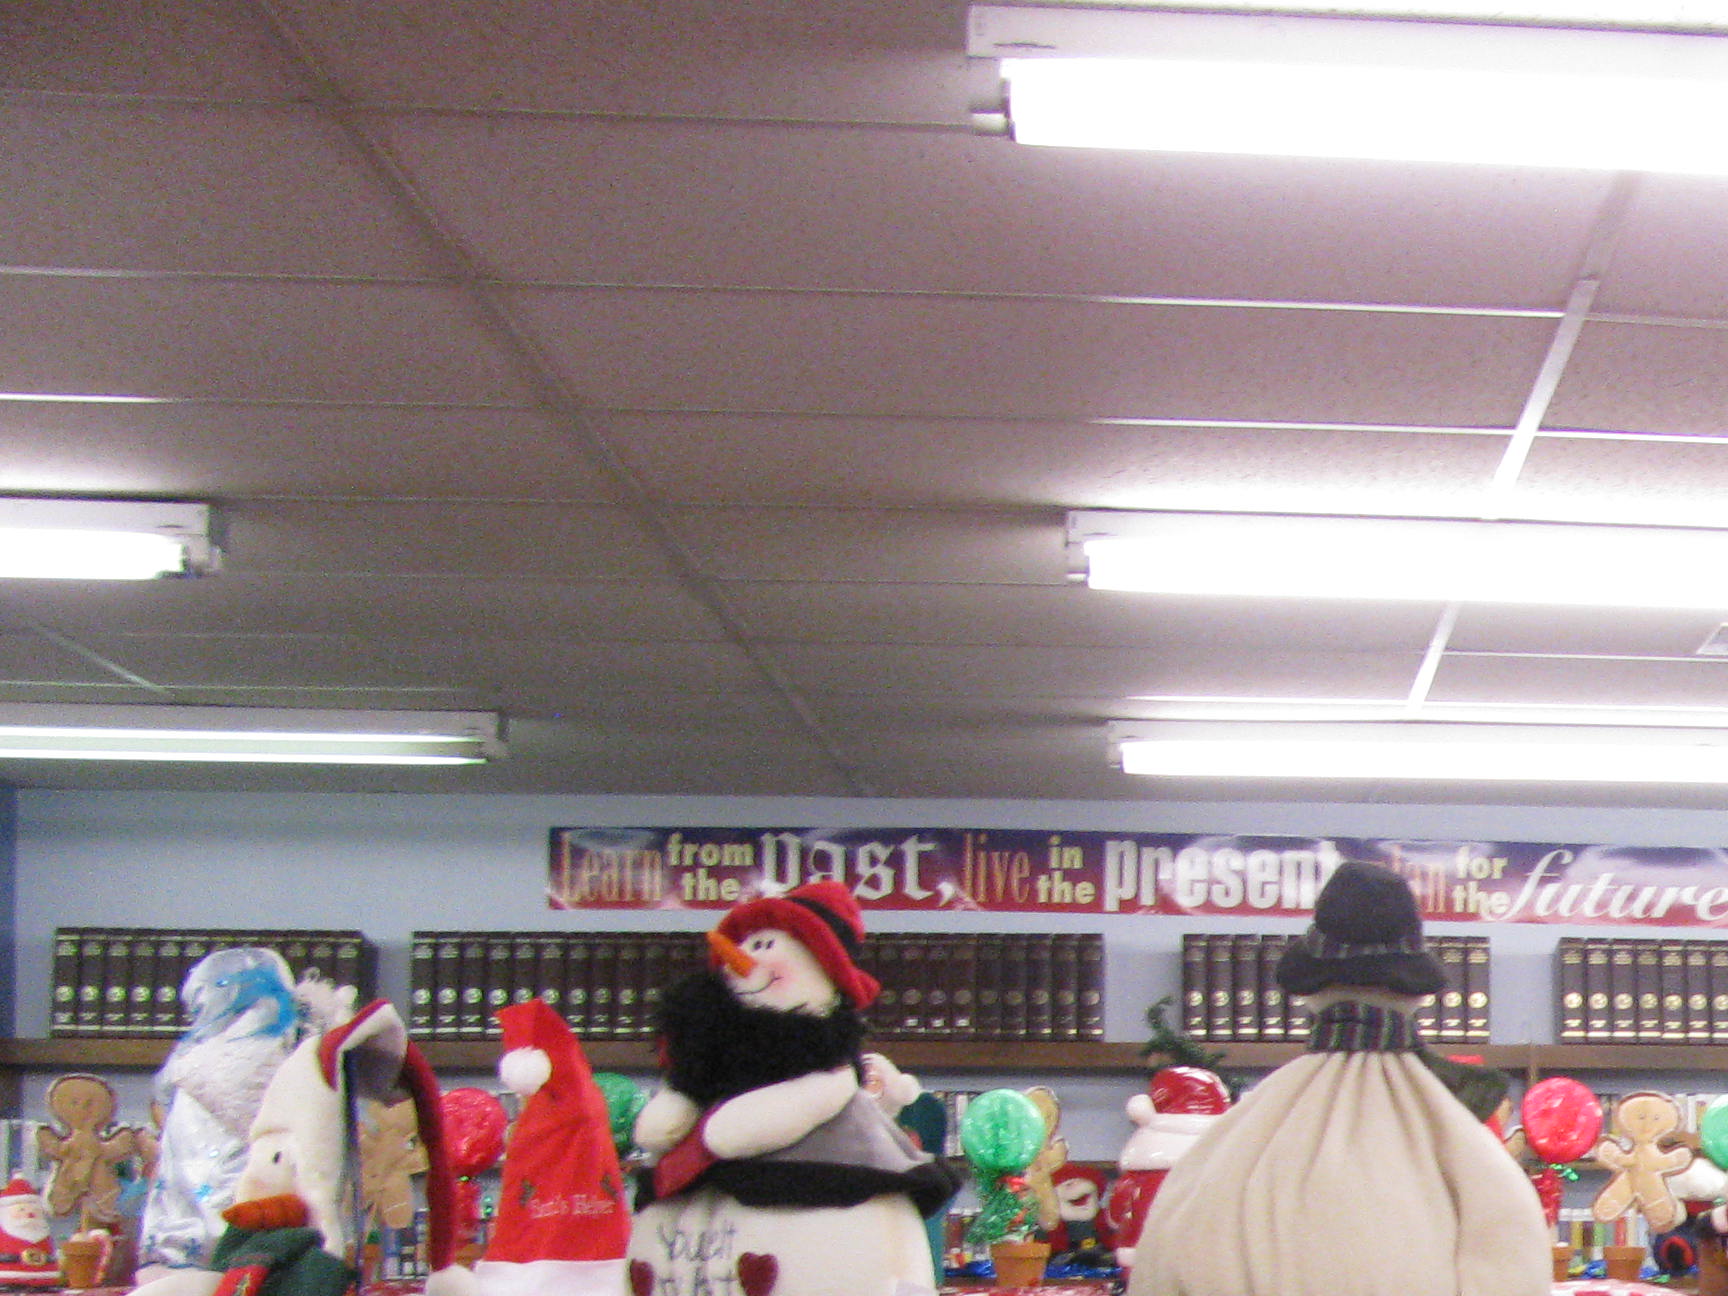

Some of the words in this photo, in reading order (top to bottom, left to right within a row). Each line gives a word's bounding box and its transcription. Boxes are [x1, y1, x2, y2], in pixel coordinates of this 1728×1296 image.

[668, 833, 755, 869] from
[963, 831, 1031, 904] live
[1047, 834, 1083, 870] in
[1455, 845, 1508, 881] for
[681, 871, 741, 902] the
[1036, 872, 1095, 906] the
[1453, 882, 1509, 915] the
